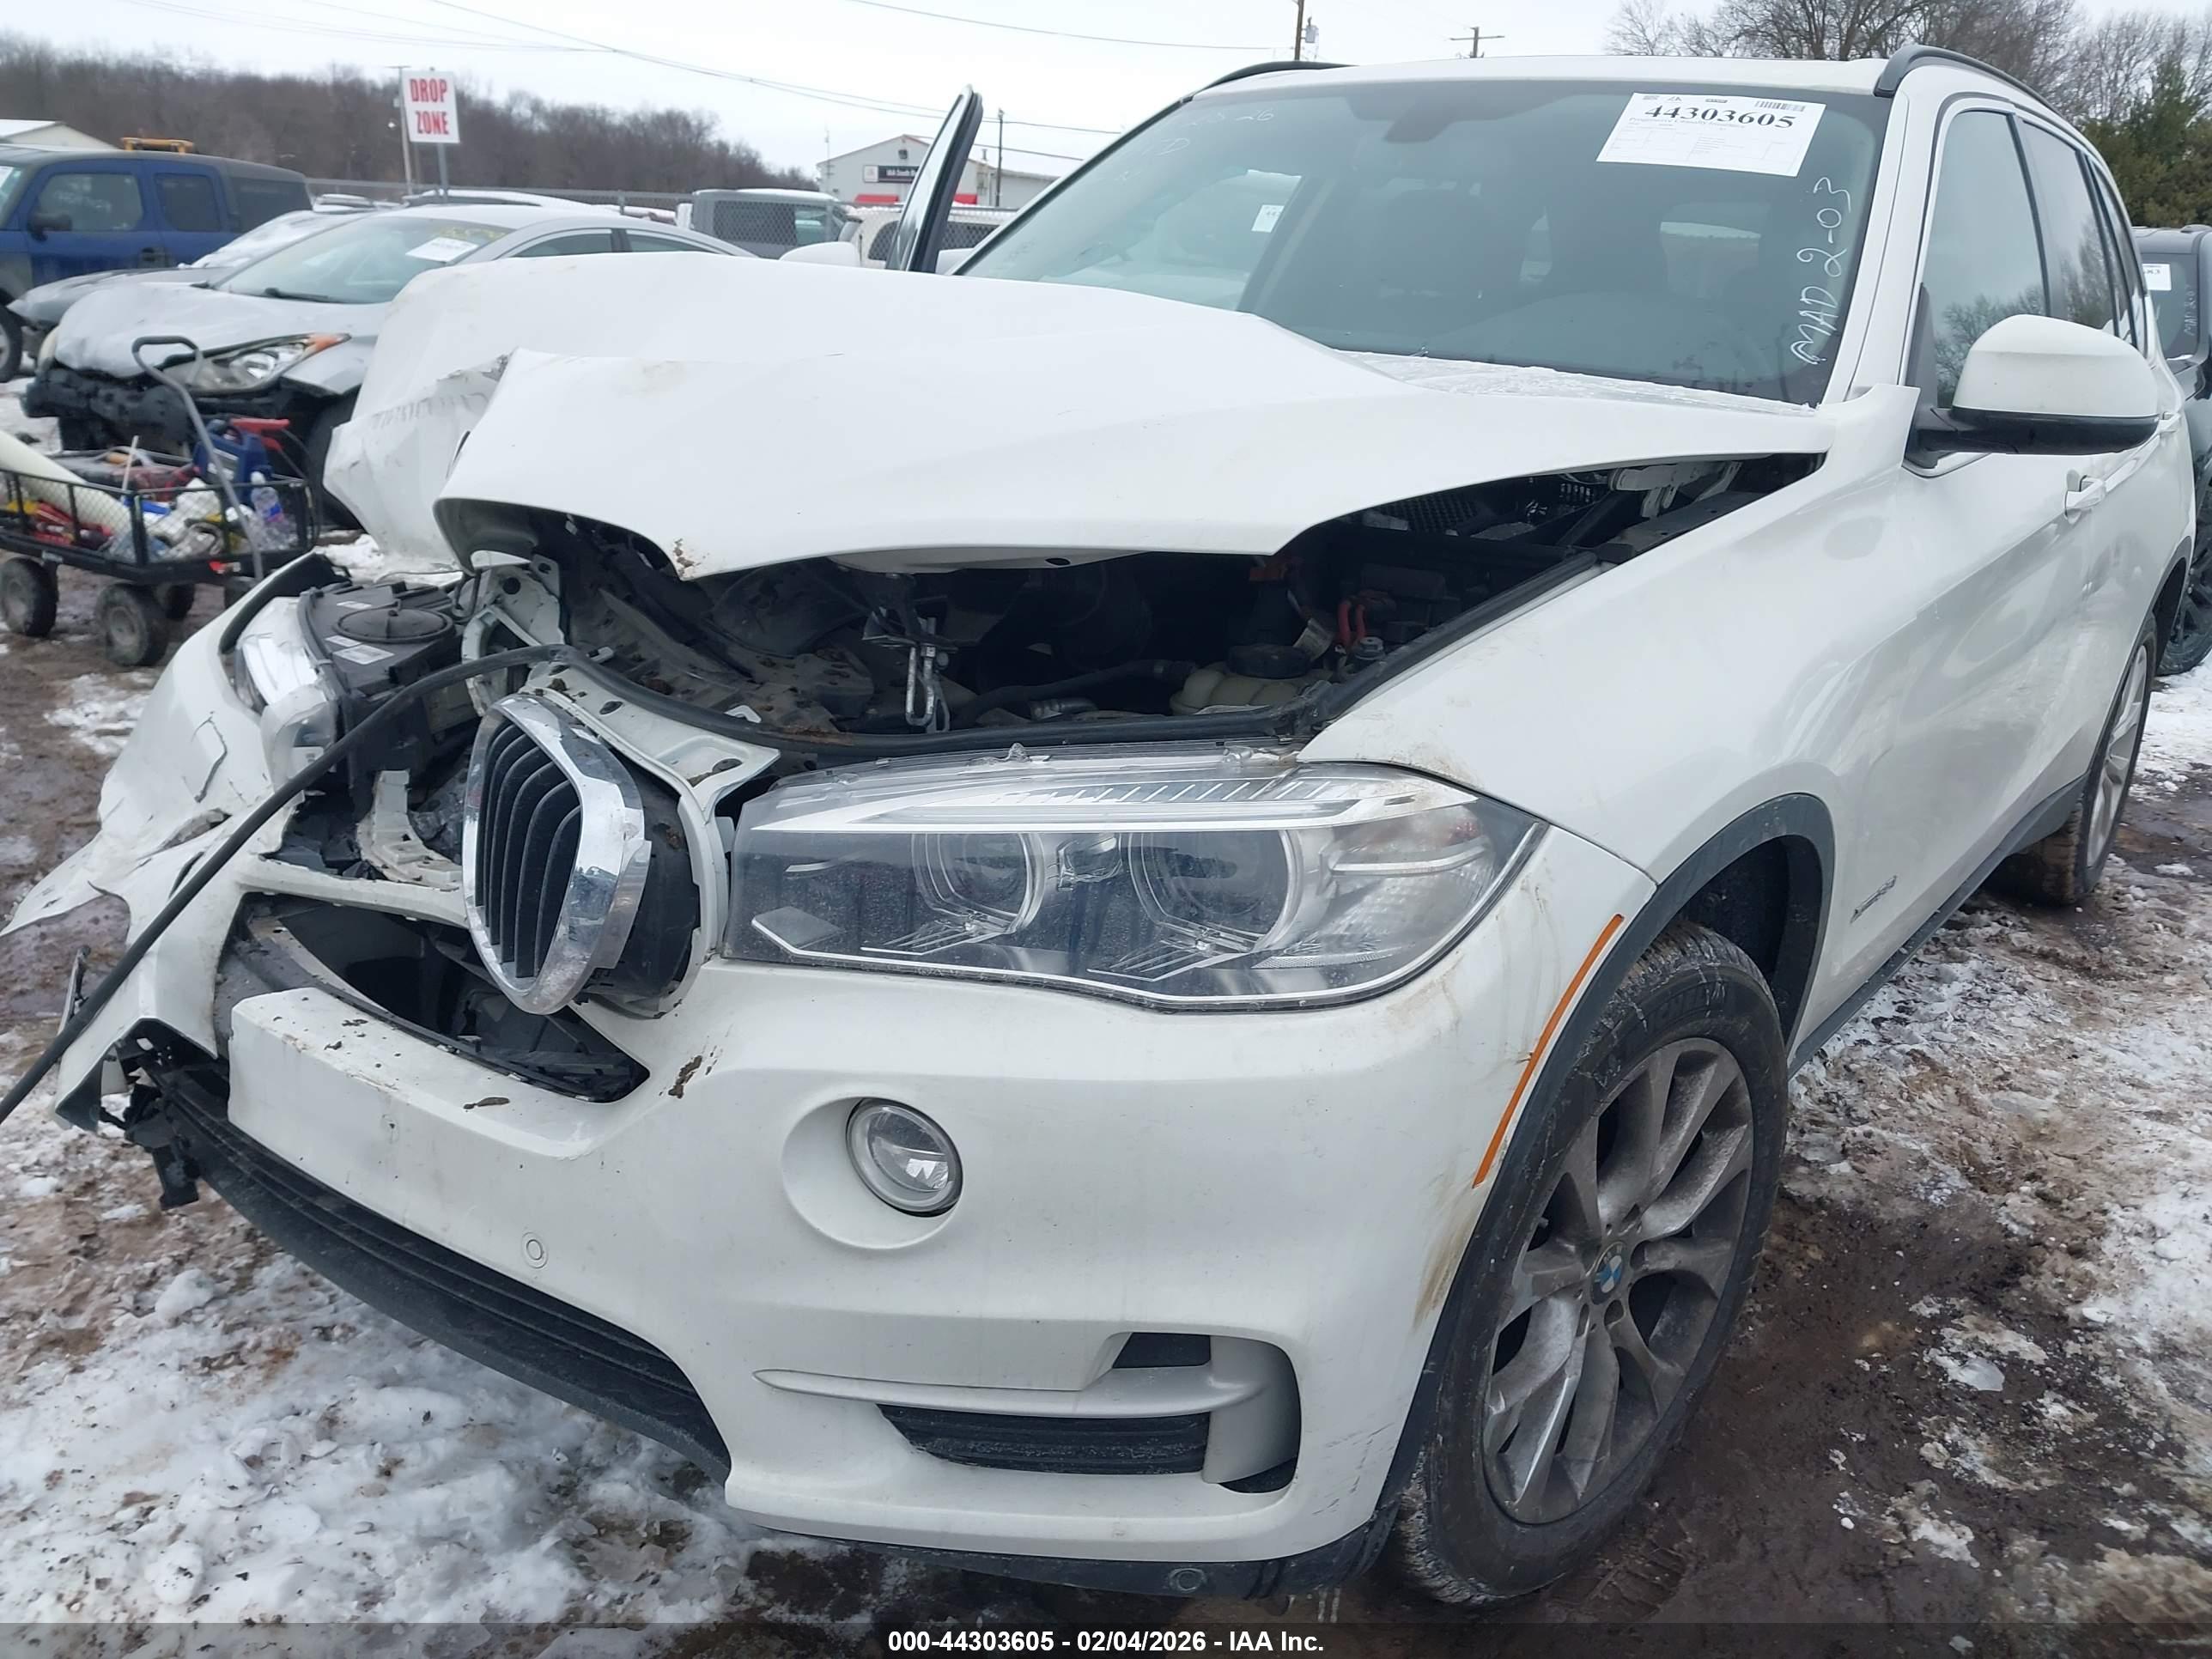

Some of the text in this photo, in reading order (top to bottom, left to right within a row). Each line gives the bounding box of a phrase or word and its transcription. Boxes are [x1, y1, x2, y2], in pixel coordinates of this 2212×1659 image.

[410, 78, 447, 102] DROP
[416, 110, 449, 135] ZONE
[1644, 105, 1797, 128] 44303605
[1796, 177, 1851, 277] 2-03
